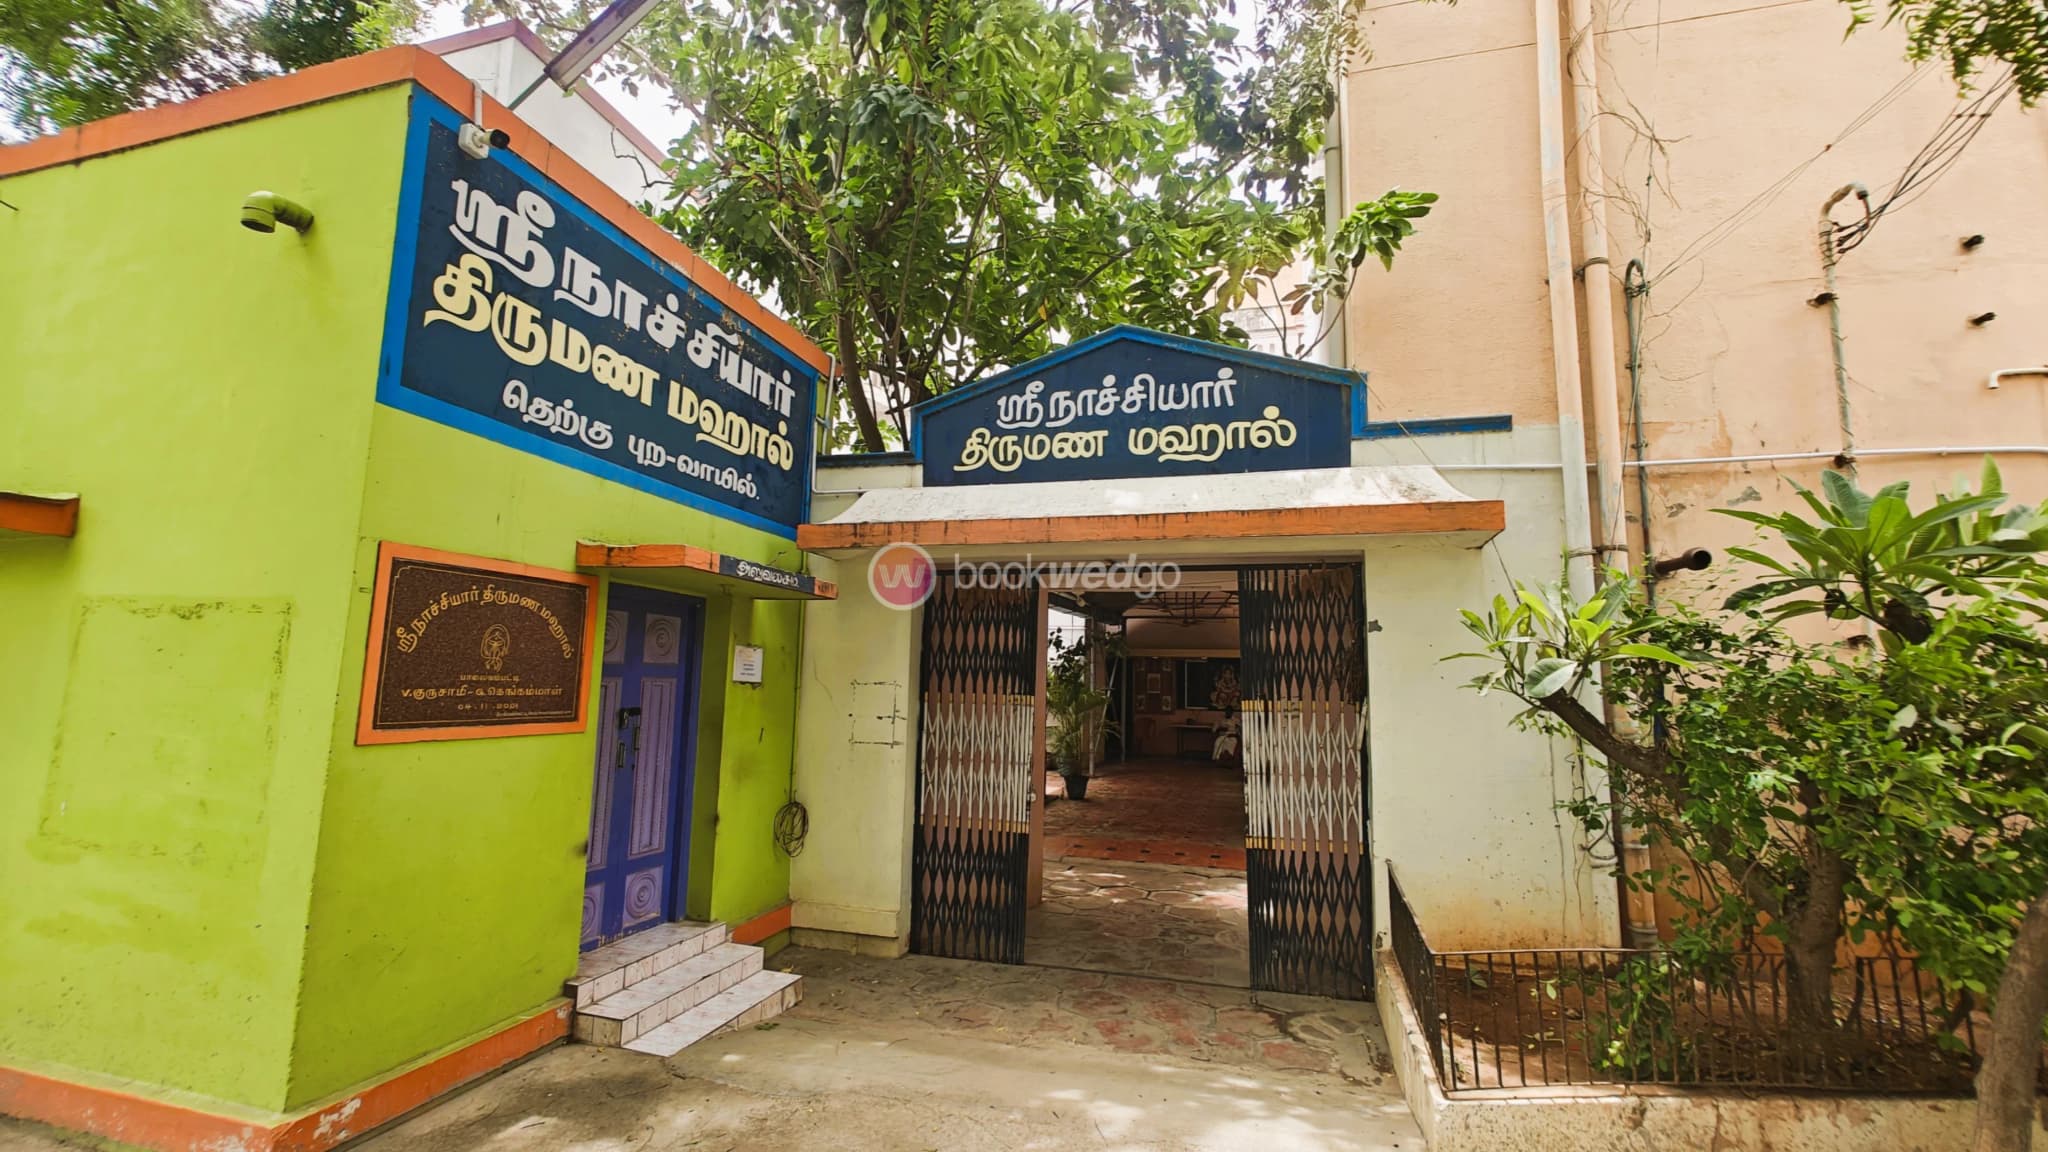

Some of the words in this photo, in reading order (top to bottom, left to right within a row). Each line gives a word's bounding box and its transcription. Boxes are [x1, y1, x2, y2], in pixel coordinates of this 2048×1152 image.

[423, 253, 660, 407] திருமண
[667, 380, 796, 471] மஹால்
[553, 246, 796, 418] நாச்சியார்
[502, 379, 614, 450] தெற்கு
[1045, 366, 1237, 429] நாச்சியார்
[953, 427, 1109, 471] திருமண
[1128, 405, 1298, 463] மஹால்
[479, 584, 541, 612] திருமண
[540, 605, 575, 659] மஹால்
